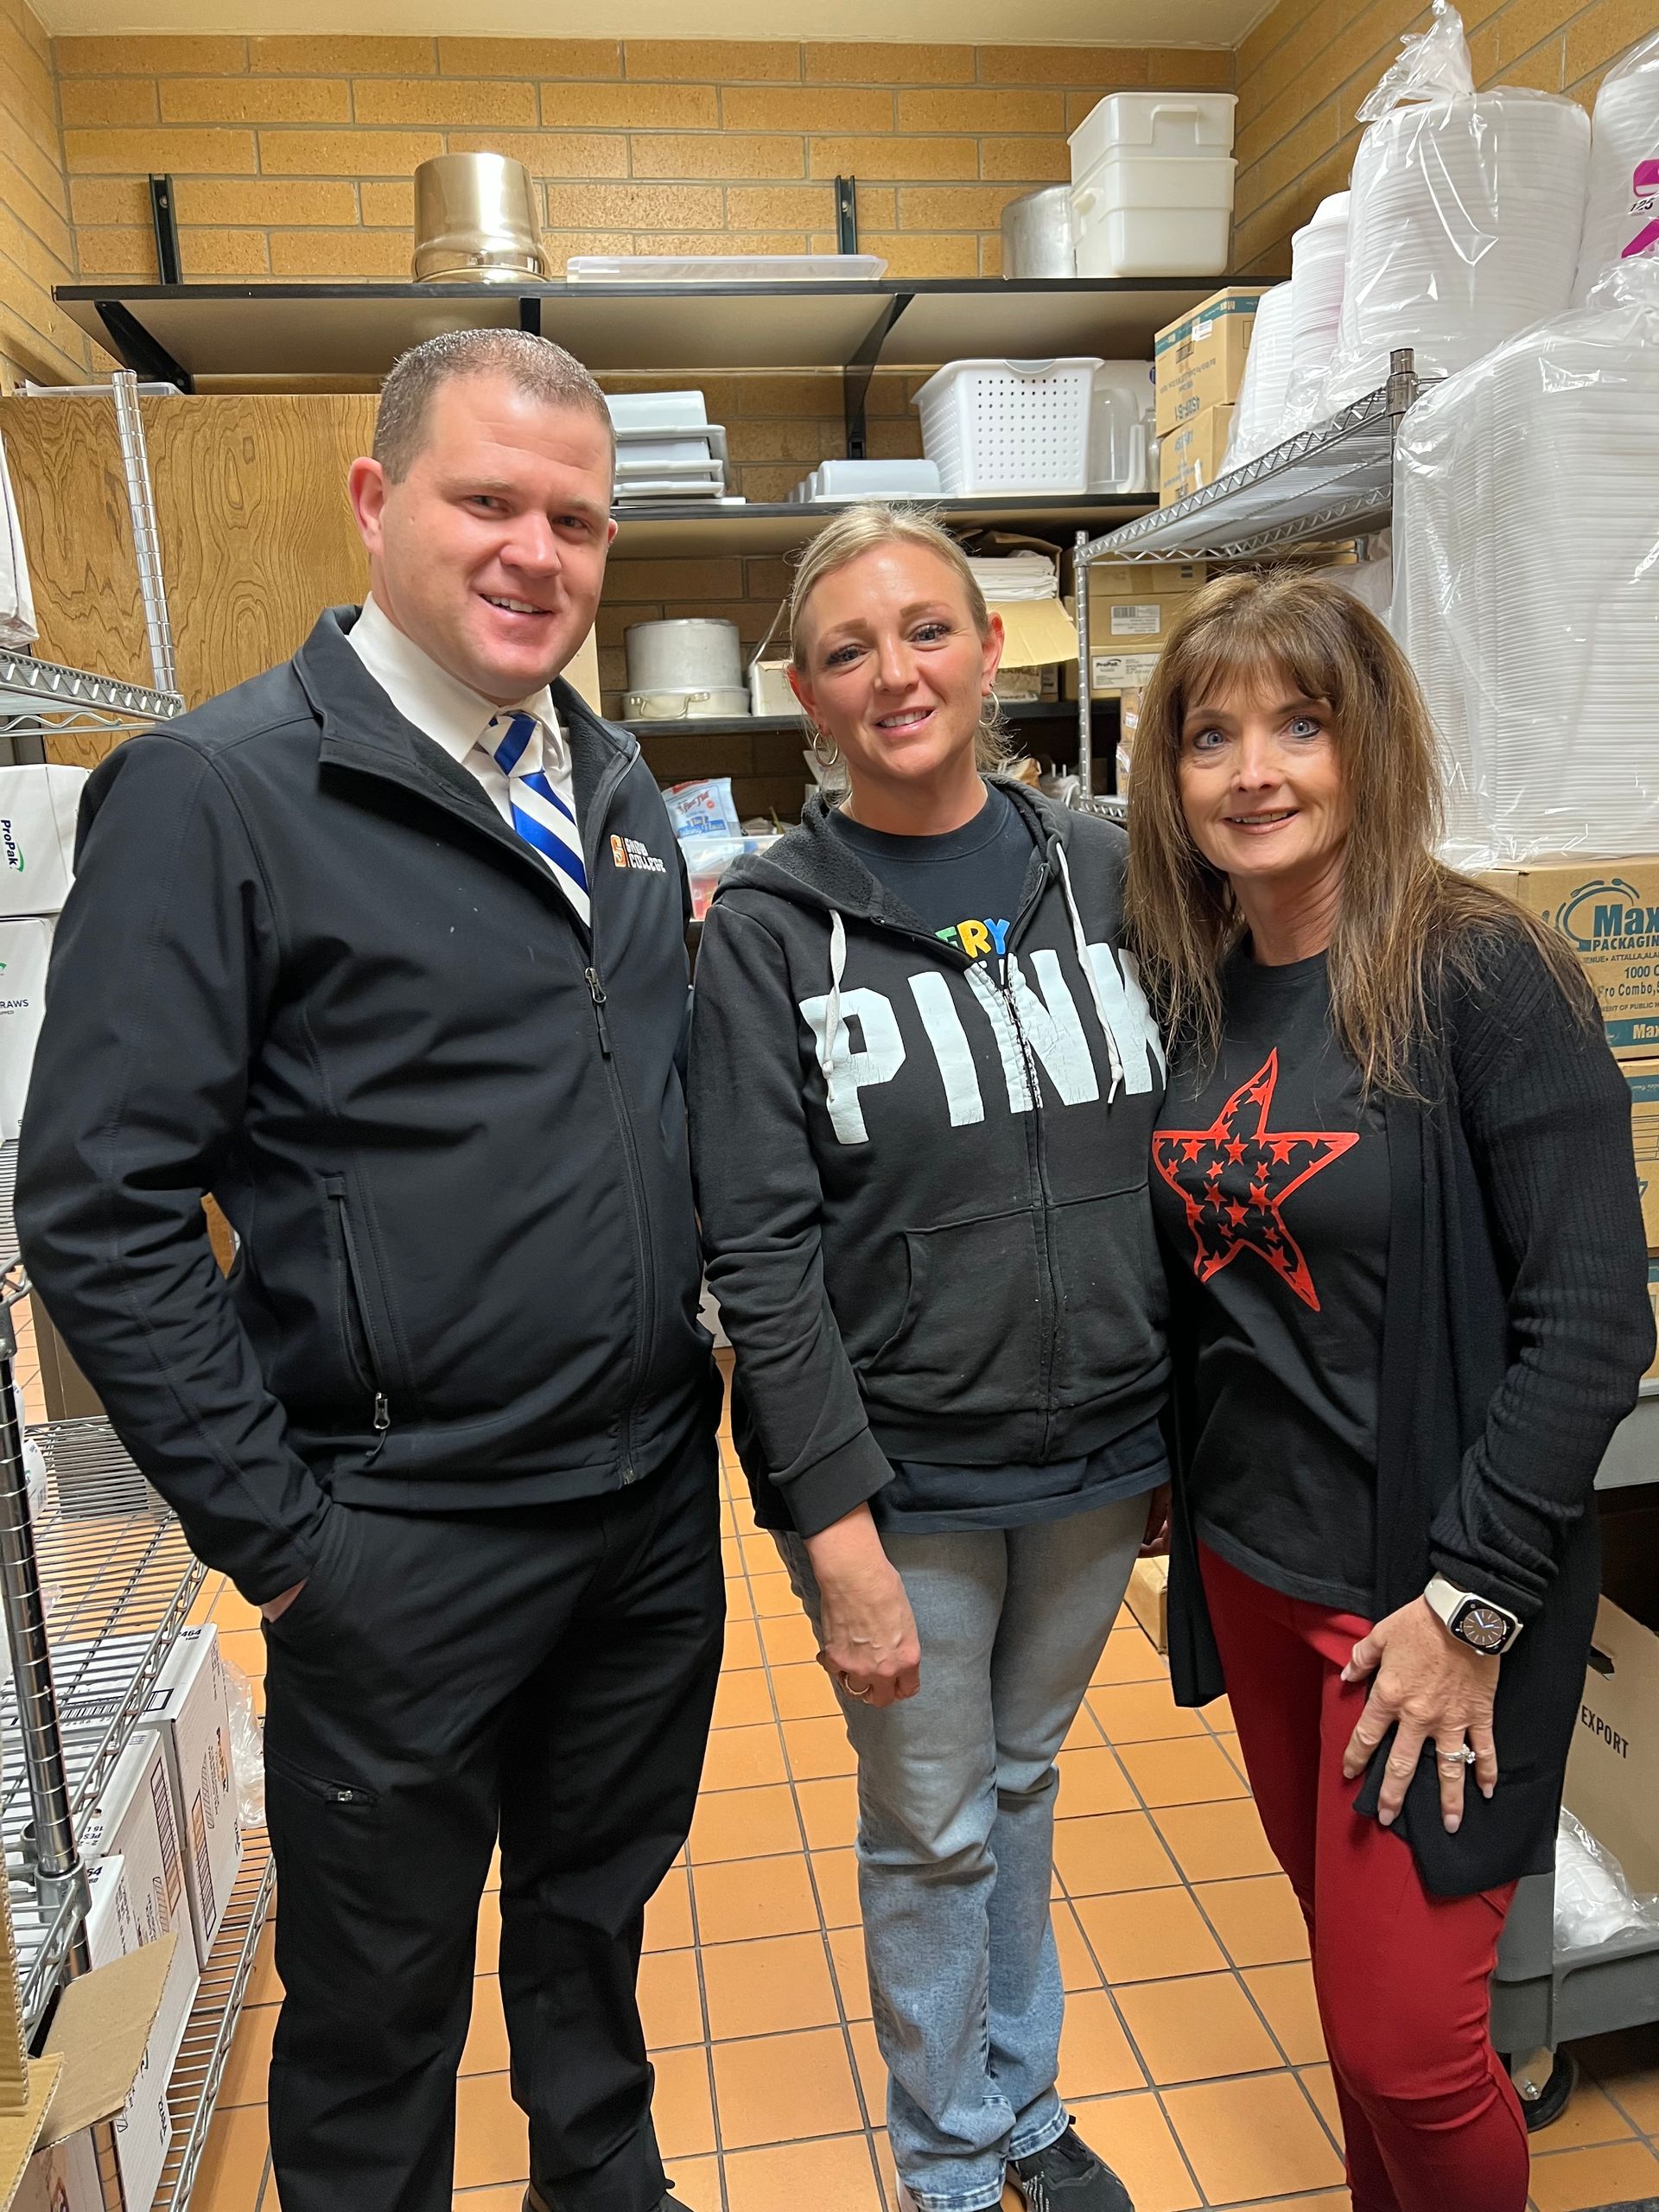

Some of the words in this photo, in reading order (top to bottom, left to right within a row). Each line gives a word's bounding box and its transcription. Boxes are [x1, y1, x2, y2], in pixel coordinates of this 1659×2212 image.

[1, 819, 18, 866] ProPak
[1624, 965, 1650, 979] 1000
[798, 942, 1166, 1145] PINK
[1581, 1705, 1630, 1759] EXPORT
